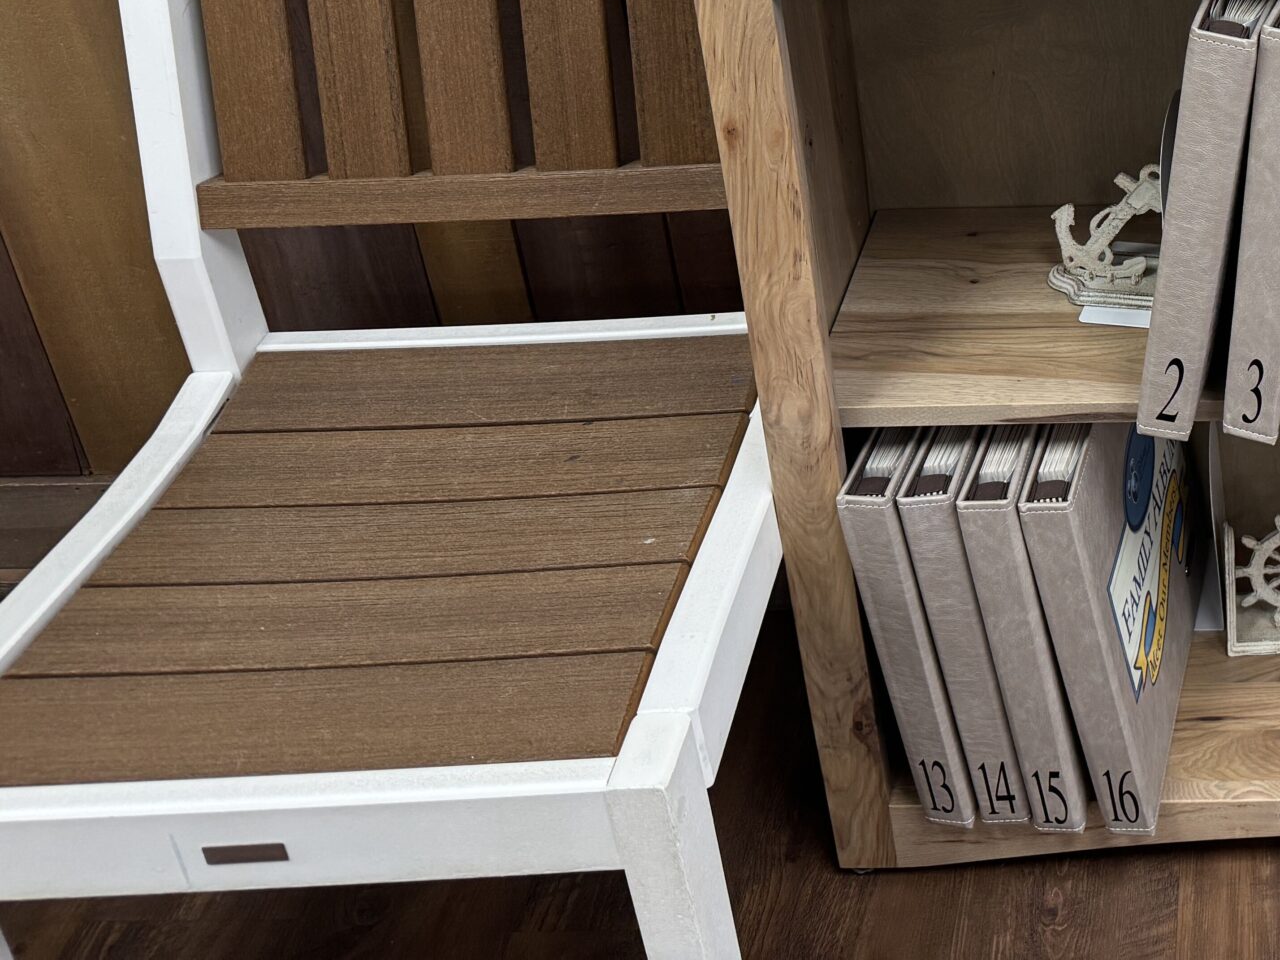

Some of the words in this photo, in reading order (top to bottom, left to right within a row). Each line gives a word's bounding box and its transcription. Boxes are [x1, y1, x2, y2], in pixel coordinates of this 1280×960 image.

[1155, 357, 1185, 423] 2
[1241, 358, 1264, 424] 3
[1122, 512, 1154, 644] FAMILY
[1149, 630, 1163, 678] Meet
[1158, 578, 1168, 622] Our
[918, 759, 955, 814] 13
[977, 761, 1016, 815] 14
[1031, 770, 1069, 825] 15
[1102, 769, 1140, 824] 16
